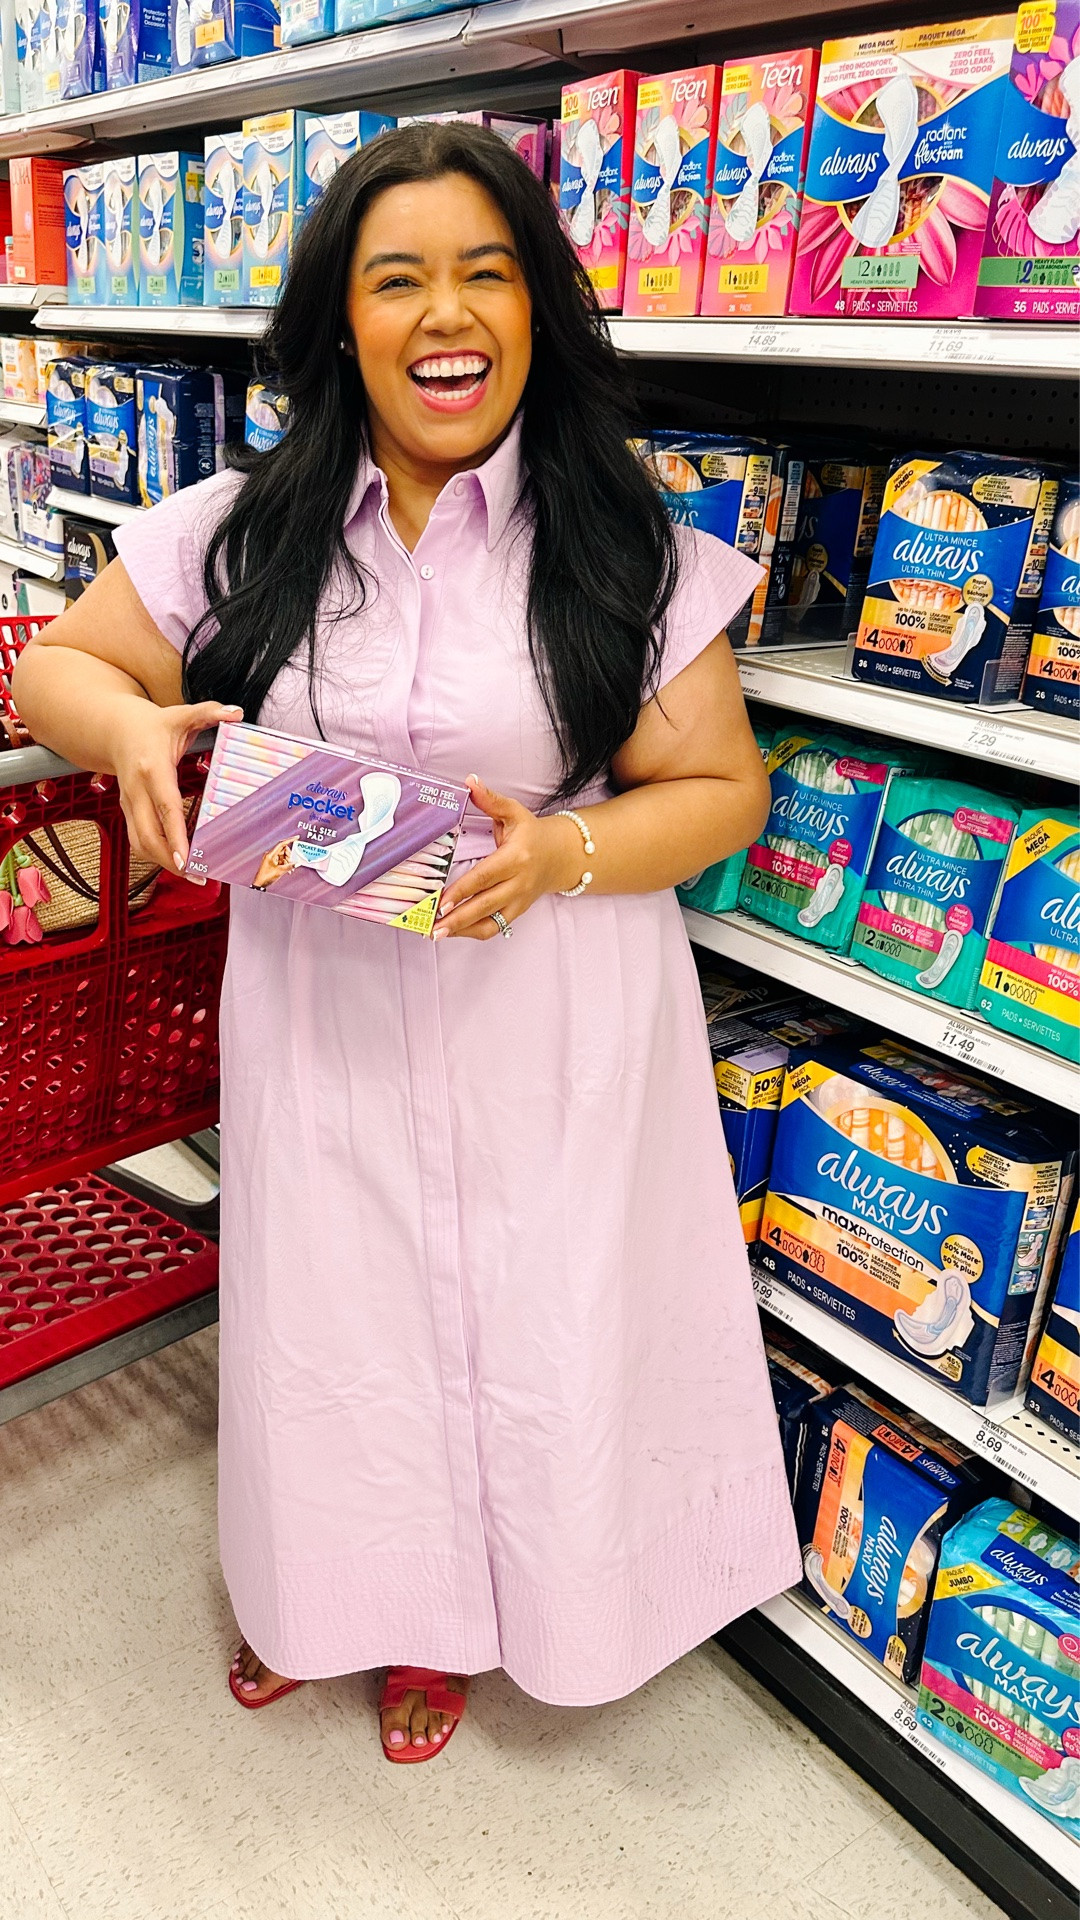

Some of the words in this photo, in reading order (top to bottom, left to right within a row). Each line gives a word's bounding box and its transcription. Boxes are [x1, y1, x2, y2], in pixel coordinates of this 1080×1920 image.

[143, 8, 167, 16] Protection
[858, 42, 877, 50] MEGA
[877, 39, 895, 47] PACK
[918, 32, 944, 42] PAQUET
[945, 28, 966, 38] MÉGA
[953, 51, 972, 60] ZERO
[973, 48, 993, 57] FEEL,
[838, 64, 854, 73] ZÉRO
[875, 66, 898, 75] ODEUR
[949, 60, 969, 68] ZERO
[950, 67, 969, 76] ZERO
[970, 65, 992, 74] ODOR
[760, 62, 803, 90] Teen
[586, 86, 620, 111] Teen
[670, 78, 708, 104] Teen
[925, 122, 967, 143] radiant
[914, 136, 963, 170] flexfoam
[1007, 132, 1068, 165] always
[716, 164, 748, 186] always
[819, 147, 880, 184] always
[562, 177, 584, 193] always
[634, 174, 662, 194] always
[205, 202, 224, 221] always
[861, 260, 870, 277] 2
[1020, 260, 1033, 283] 2
[834, 300, 845, 311] 48
[852, 300, 870, 312] PADS
[877, 300, 918, 313] SERVIETTES
[1013, 301, 1027, 313] 36
[1032, 301, 1050, 314] PADS
[748, 335, 777, 346] 14.89
[928, 340, 963, 352] 11.69
[93, 409, 118, 433] always
[893, 470, 914, 492] JUMBO
[1042, 519, 1048, 528] 9
[67, 537, 92, 562] always
[924, 532, 949, 544] ULTRA
[950, 537, 979, 548] MINCE
[893, 531, 984, 581] always
[901, 565, 926, 576] ULTRA
[926, 569, 946, 579] THIN
[895, 613, 926, 629] 100%
[866, 628, 879, 648] 4
[858, 659, 868, 668] 36
[875, 662, 889, 673] PADS
[892, 666, 921, 680] SERVIETTES
[1042, 661, 1054, 676] 4
[1035, 690, 1046, 699] 26
[1053, 694, 1067, 705] PADS
[977, 720, 1003, 731] ALWAYS
[967, 731, 997, 747] 7.29
[306, 781, 347, 801] always
[420, 784, 439, 796] ZERO
[439, 789, 458, 802] FEEL,
[288, 792, 355, 821] pocket
[418, 793, 437, 805] ZERO
[437, 799, 460, 812] LEAKS
[772, 789, 849, 842] always
[297, 821, 318, 832] FULL
[319, 826, 337, 838] SIZE
[306, 831, 324, 842] PAD
[1023, 825, 1044, 844] PAQUET
[297, 843, 317, 852] POCKET
[1025, 832, 1051, 854] MEGA
[1033, 844, 1050, 857] PACK
[192, 848, 204, 859] 22
[189, 861, 208, 874] PADS
[771, 860, 796, 878] 100%
[917, 852, 942, 868] ULTRA
[942, 860, 967, 876] MINCE
[751, 870, 761, 888] 2
[885, 850, 971, 902] always
[893, 877, 916, 893] ULTRA
[916, 885, 934, 899] THIN
[430, 897, 437, 910] 1
[865, 929, 876, 947] 2
[891, 922, 915, 940] 100%
[1050, 926, 1079, 946] ULTRA
[995, 971, 1003, 989] 1
[1047, 974, 1079, 997] 100%
[948, 1020, 973, 1034] ALWAYS
[980, 998, 993, 1011] 62
[1001, 1008, 1019, 1023] PADS
[1022, 1017, 1061, 1042] SERVIETTES
[942, 1031, 975, 1052] 11.49
[816, 1150, 948, 1236] always
[1035, 1195, 1046, 1206] 12
[852, 1194, 895, 1230] MAXI
[769, 1226, 782, 1247] 4
[822, 1205, 924, 1271] maxProtection
[1029, 1233, 1036, 1242] 6
[836, 1243, 869, 1270] 100%
[944, 1242, 959, 1255] 50%
[953, 1241, 974, 1255] Absorbs
[871, 1254, 898, 1271] LEAK-FREE
[871, 1258, 902, 1279] PROTECTION
[942, 1254, 952, 1265] 50
[752, 1267, 772, 1283] ALWAYS
[869, 1270, 883, 1281] SANS
[882, 1276, 900, 1290] FUITES
[870, 1265, 901, 1286] PROTECTION
[762, 1256, 776, 1271] 48
[787, 1270, 806, 1290] PADS
[812, 1286, 856, 1321] SERVIETTES
[1040, 1369, 1055, 1390] 4
[1029, 1400, 1041, 1413] 33
[1049, 1414, 1065, 1430] PADS
[983, 1419, 1008, 1438] ALWAYS
[833, 1438, 847, 1454] 4
[976, 1430, 1003, 1453] 8.69
[921, 1458, 956, 1485] always
[862, 1534, 876, 1565] MAXI
[861, 1515, 902, 1606] always
[990, 1549, 1049, 1586] always
[946, 1567, 965, 1577] PAQUET
[948, 1575, 974, 1588] JUMBO
[1002, 1565, 1023, 1581] MAXI
[993, 1673, 1037, 1711] MAXI
[930, 1697, 946, 1722] 2
[894, 1708, 918, 1731] 8.69
[921, 1716, 933, 1728] 42
[973, 1707, 1011, 1742] 100%
[1014, 1727, 1042, 1747] LEAK-FREE
